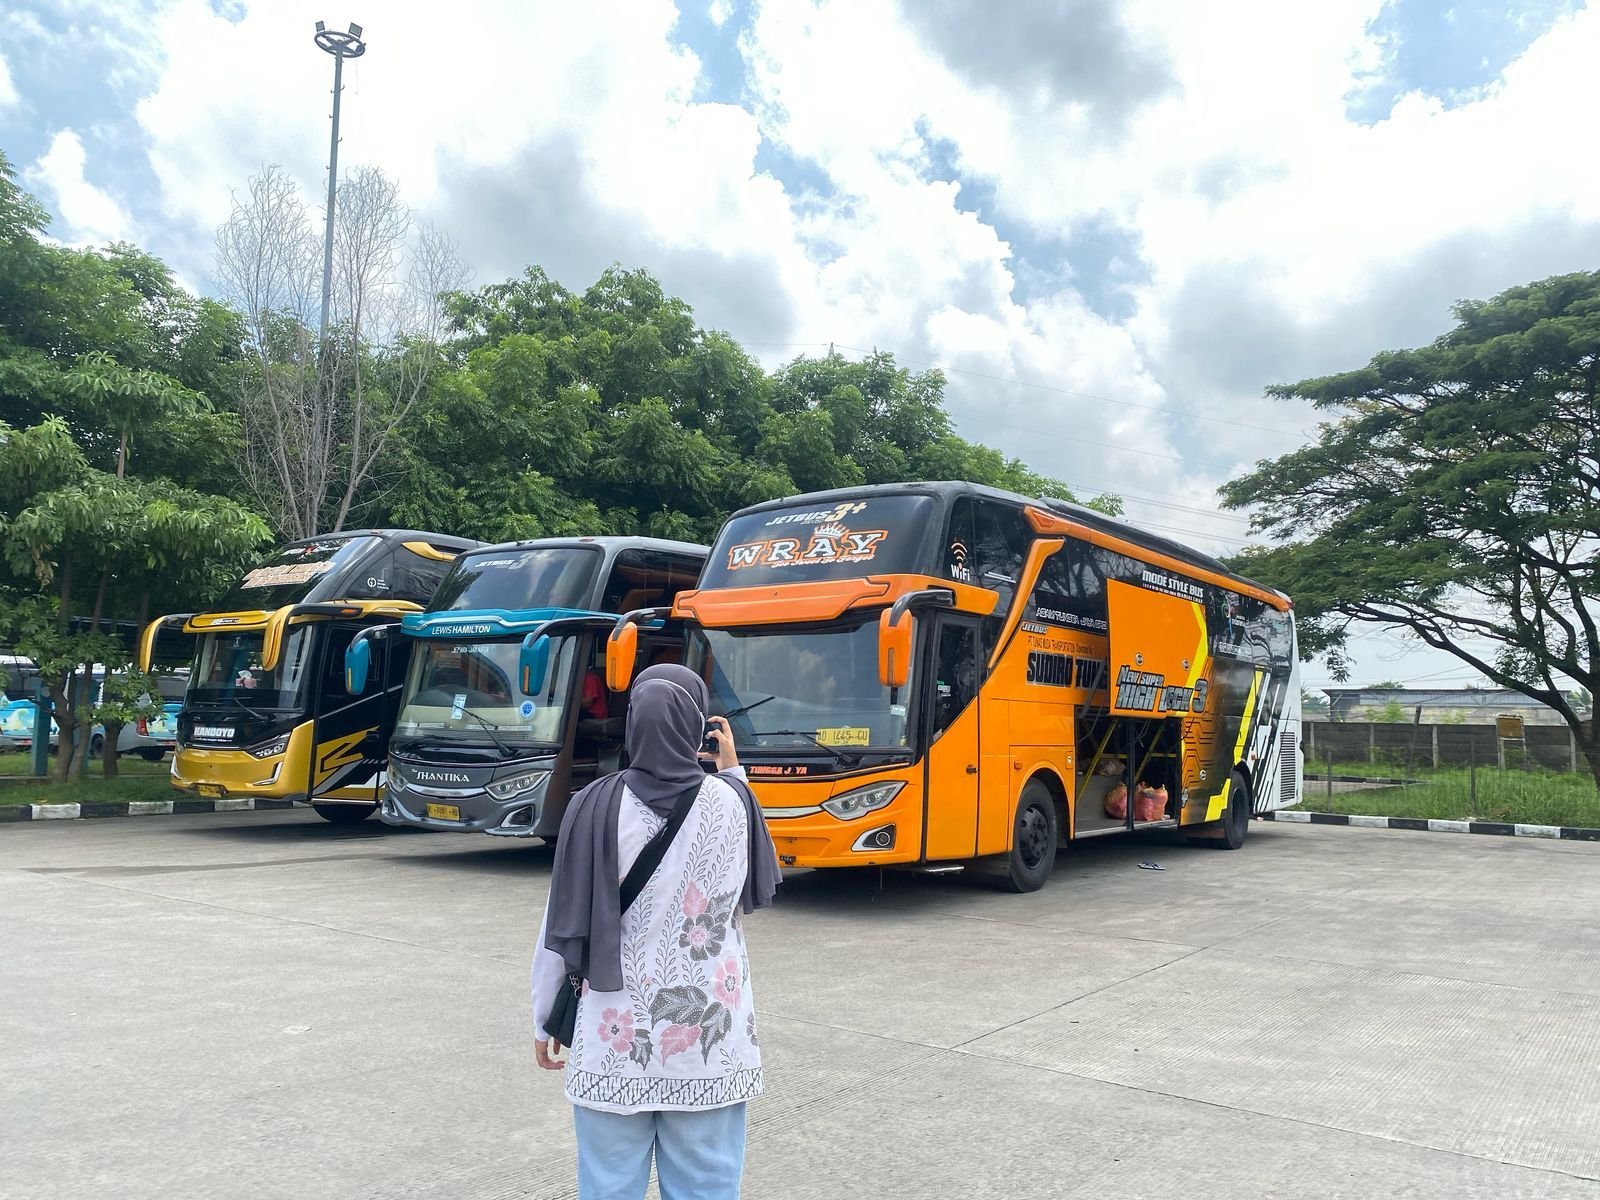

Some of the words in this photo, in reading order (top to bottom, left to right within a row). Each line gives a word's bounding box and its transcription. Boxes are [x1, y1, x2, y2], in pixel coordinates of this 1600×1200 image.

[765, 511, 831, 525] JETBUS
[730, 532, 885, 567] WRAY
[950, 564, 970, 581] WiFi
[1142, 570, 1167, 587] MODE
[1168, 578, 1189, 594] STYLE
[1190, 585, 1204, 598] BUS
[432, 626, 452, 635] LEWIS
[452, 624, 491, 634] HAMILTON
[1022, 623, 1049, 634] JETBUS
[1027, 651, 1073, 688] SUDIRO
[1115, 683, 1158, 712] HIGH
[1192, 678, 1208, 713] 3
[193, 726, 236, 738] HANDOYO
[416, 771, 470, 782] SHANTIKA
[750, 766, 783, 774] TUNGGA
[784, 766, 807, 774] JYA
